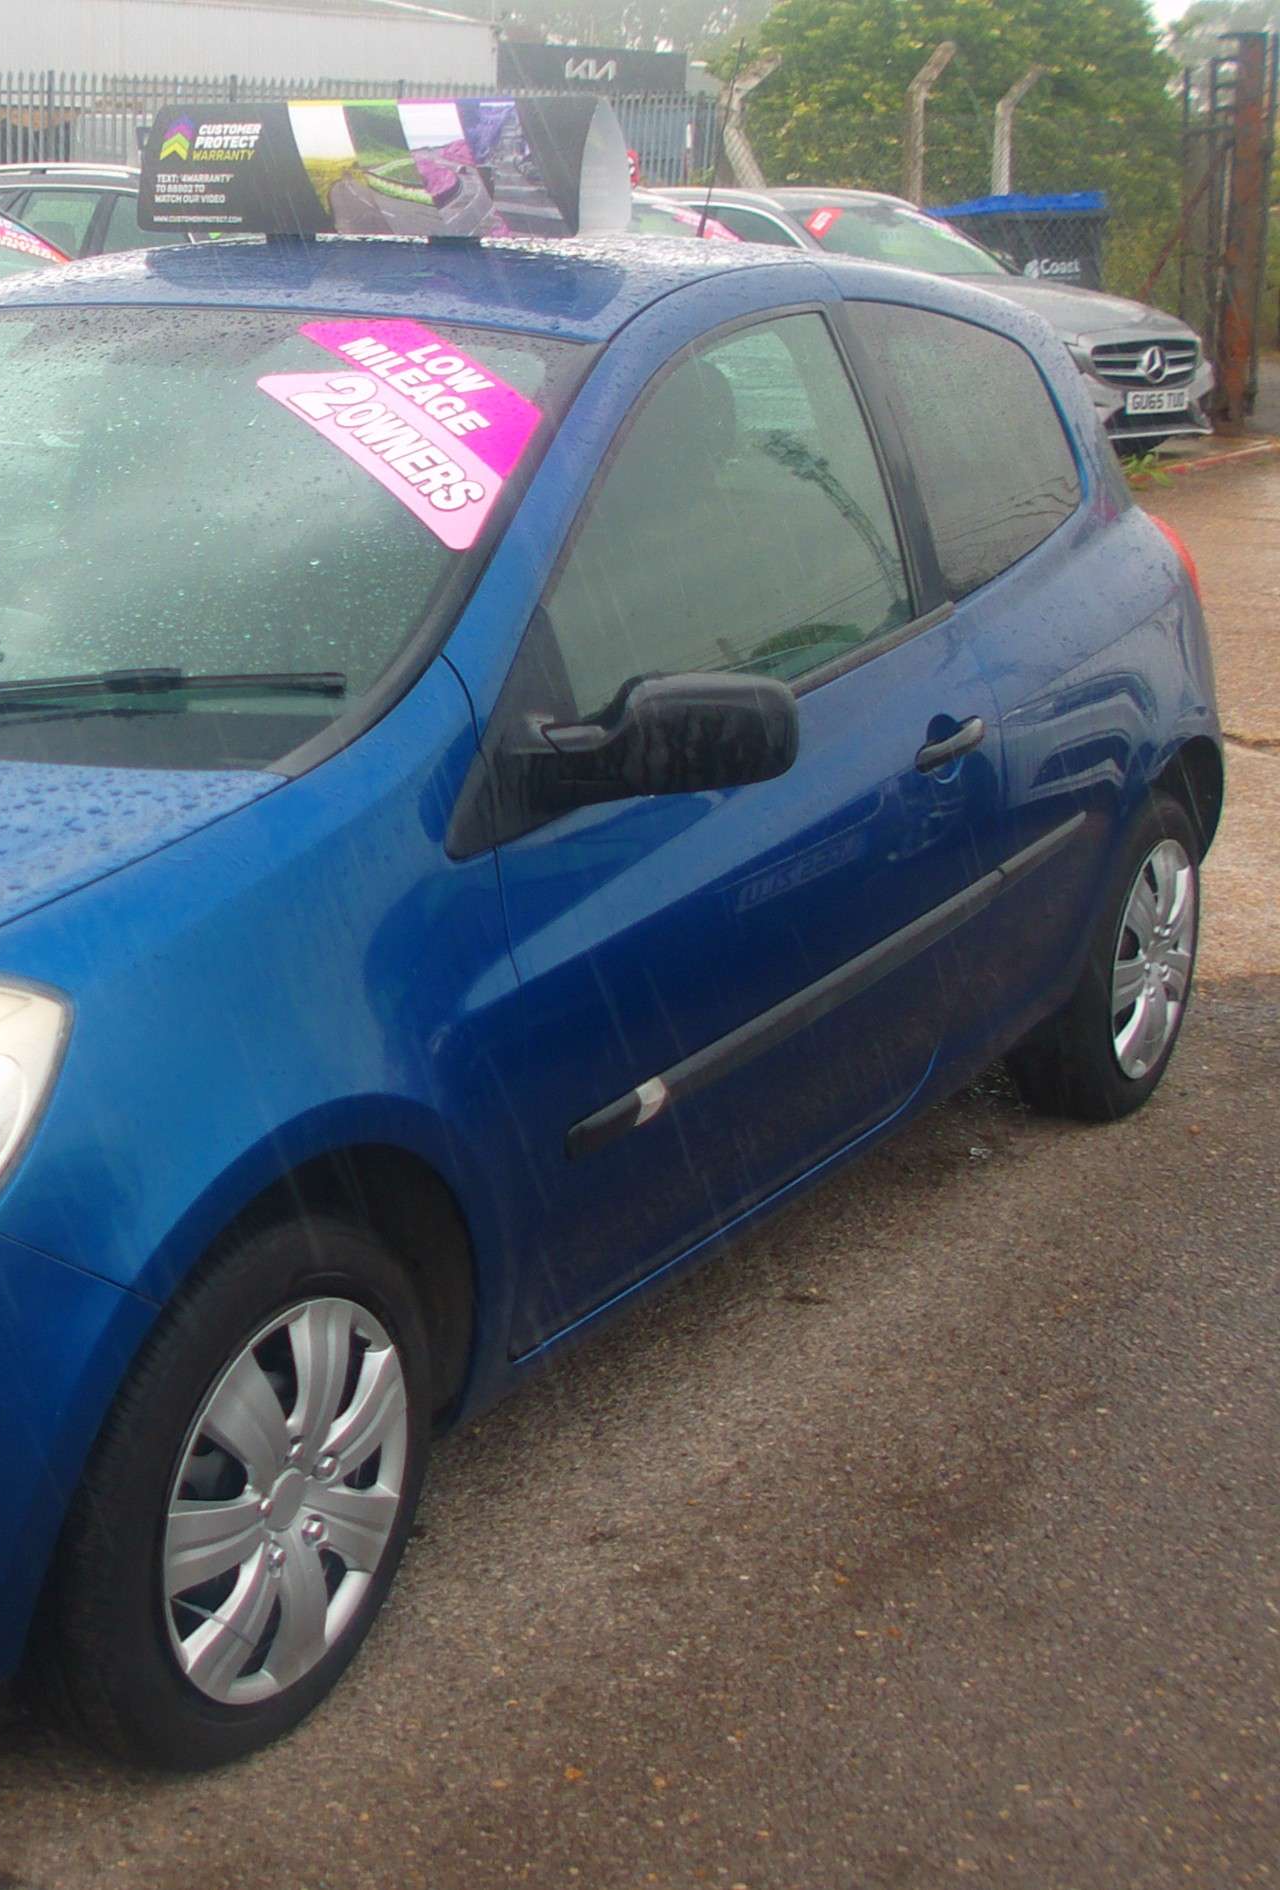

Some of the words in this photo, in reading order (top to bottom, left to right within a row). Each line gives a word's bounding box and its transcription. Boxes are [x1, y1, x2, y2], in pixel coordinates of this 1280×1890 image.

[199, 124, 262, 135] CUSTOMER
[194, 135, 259, 149] PROTECT
[192, 149, 255, 161] WARRANTY
[156, 184, 166, 193] TO
[194, 184, 206, 193] TO
[154, 194, 182, 204] WATCH
[201, 194, 226, 203] VIDEO
[1040, 258, 1080, 275] Coast
[405, 343, 496, 393] LOW
[338, 336, 491, 437] MILEAGE
[287, 375, 378, 421] 2
[334, 401, 486, 512] OWNERS
